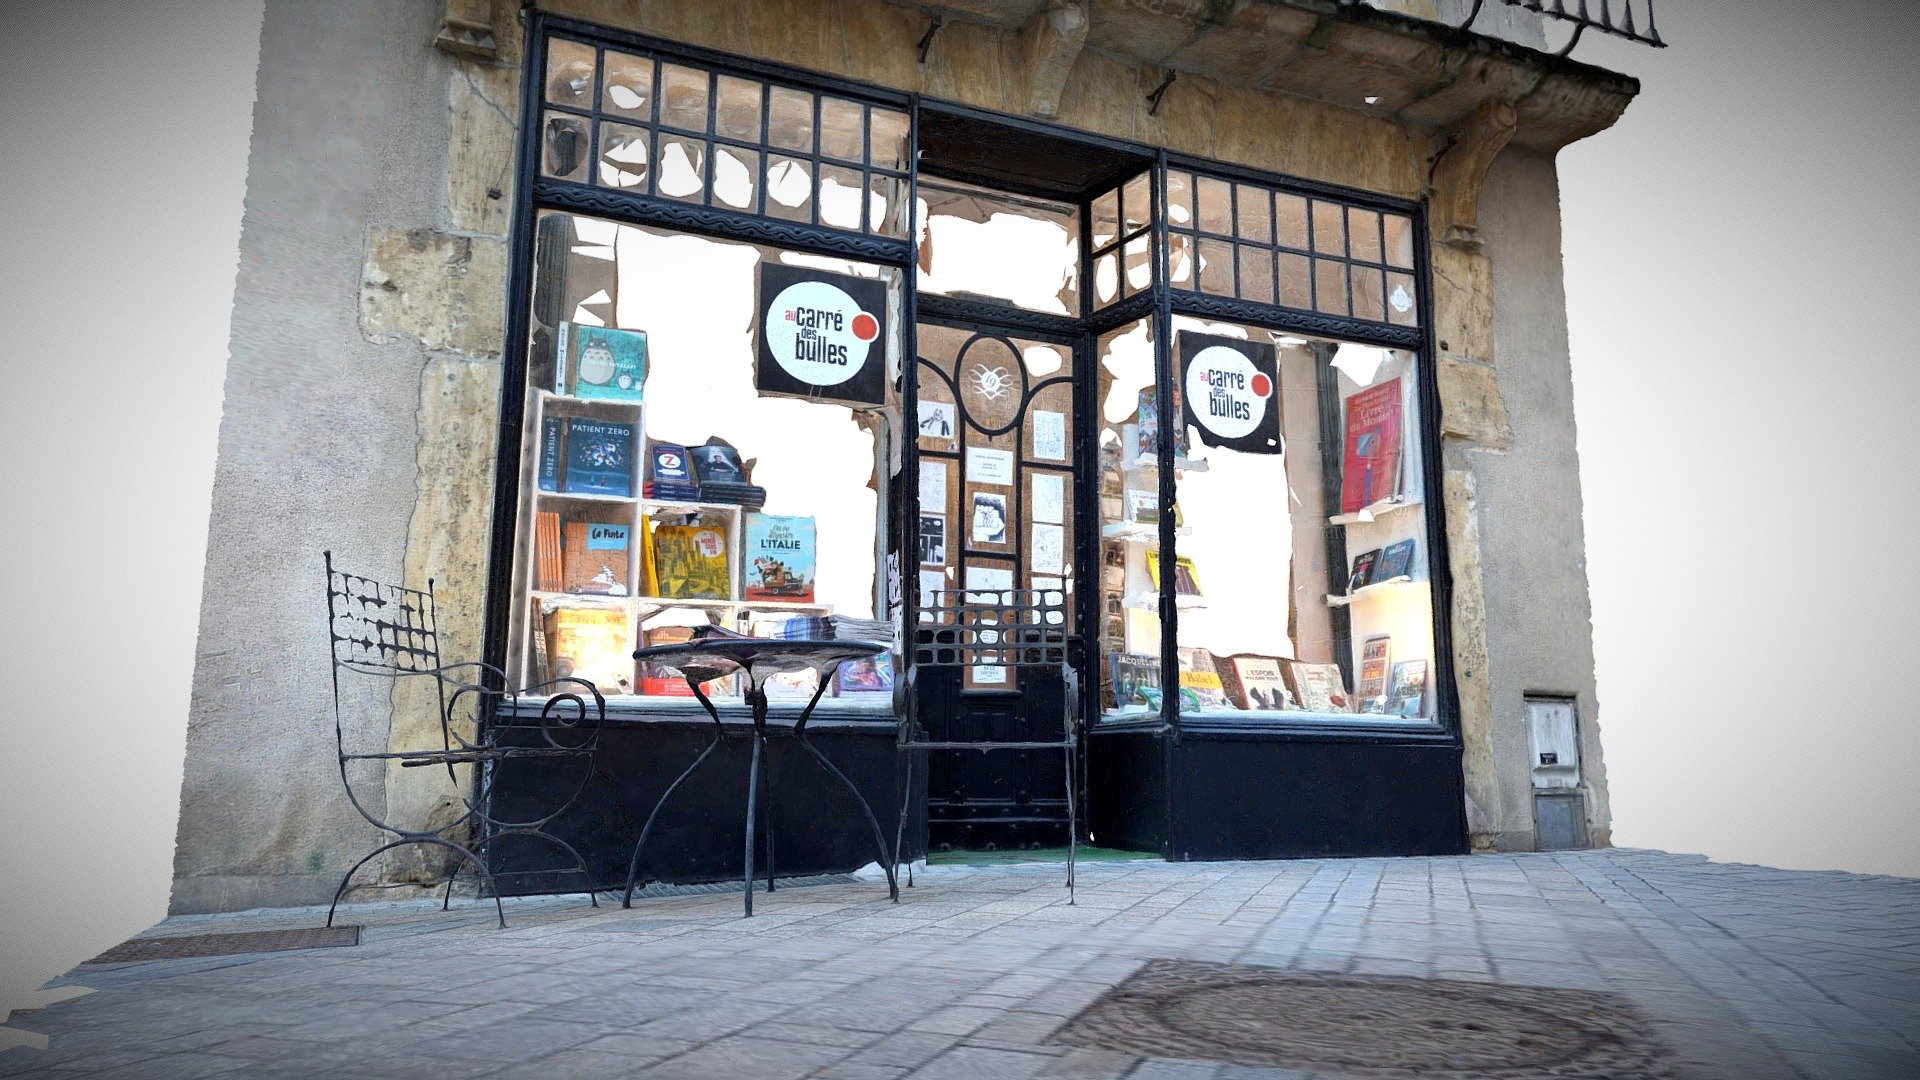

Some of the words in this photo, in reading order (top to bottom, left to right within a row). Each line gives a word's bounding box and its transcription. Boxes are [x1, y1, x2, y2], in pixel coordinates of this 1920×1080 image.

[785, 310, 797, 321] au
[797, 307, 843, 332] carré
[801, 326, 817, 340] des
[795, 332, 848, 366] bulles
[1208, 369, 1245, 390] carré
[1213, 386, 1226, 398] des
[1209, 391, 1250, 420] bulles
[572, 424, 606, 434] PATIENT
[607, 427, 630, 437] ZERO
[547, 427, 557, 456] PATIENT
[545, 458, 555, 478] ZERO
[663, 456, 677, 467] Z
[760, 539, 801, 550] L'ITALIE
